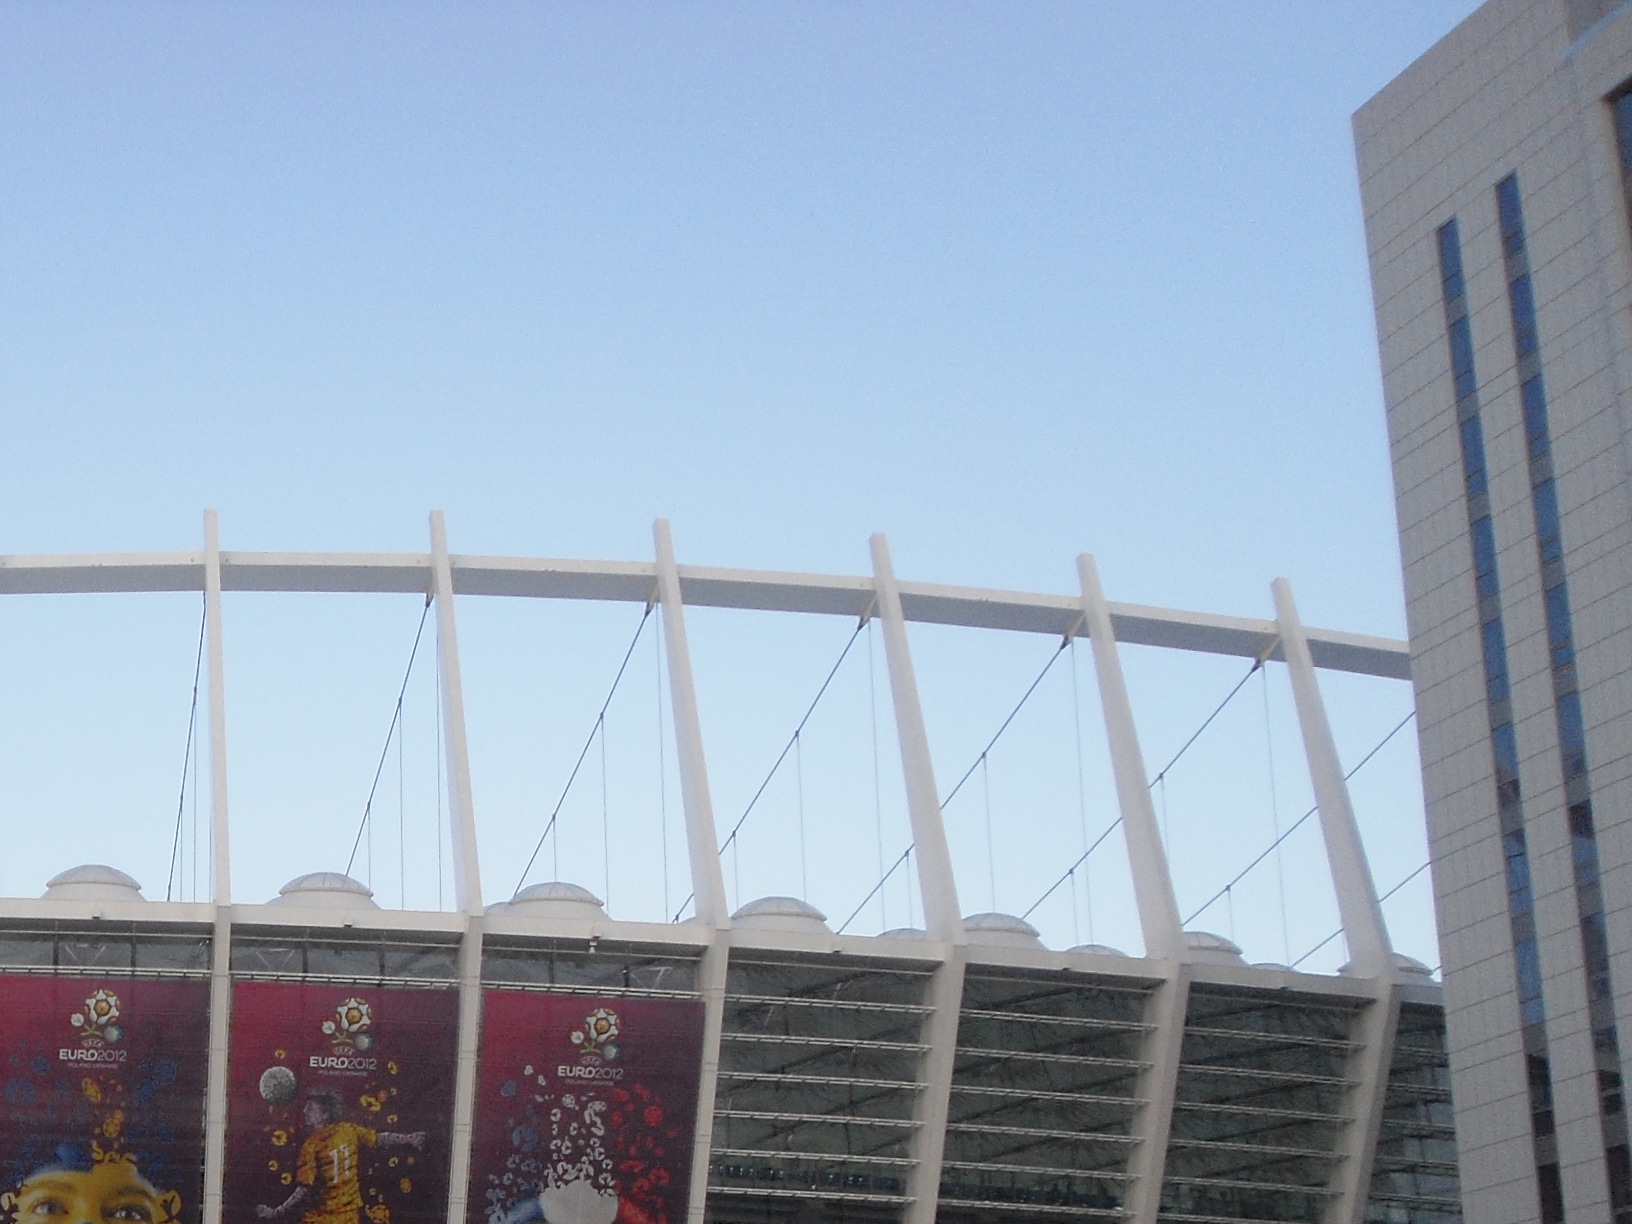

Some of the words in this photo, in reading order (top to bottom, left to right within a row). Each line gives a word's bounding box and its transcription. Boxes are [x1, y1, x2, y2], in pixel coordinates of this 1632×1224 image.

[59, 1049, 127, 1061] EURO2012
[309, 1056, 377, 1070] EURO2012
[557, 1065, 624, 1079] EURO2012
